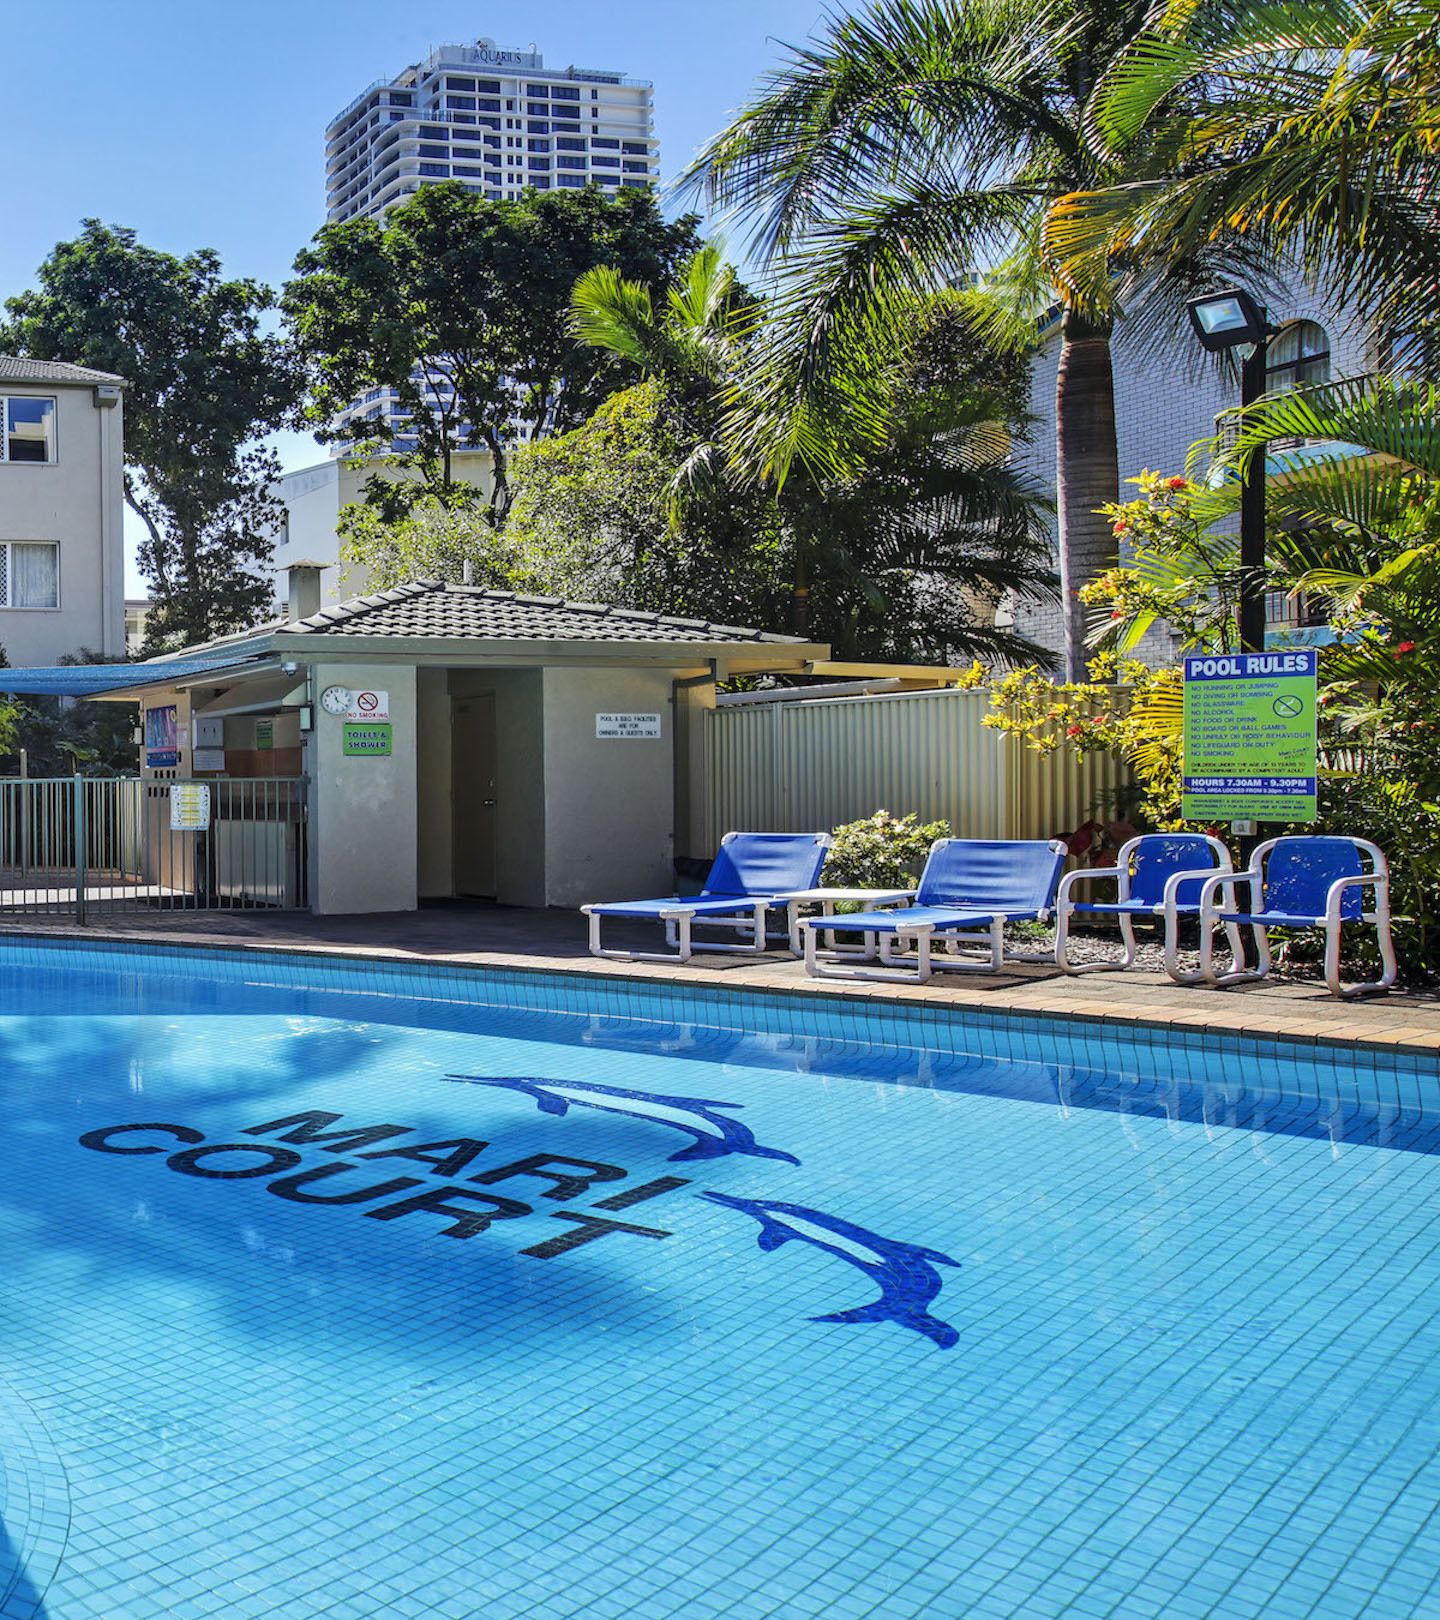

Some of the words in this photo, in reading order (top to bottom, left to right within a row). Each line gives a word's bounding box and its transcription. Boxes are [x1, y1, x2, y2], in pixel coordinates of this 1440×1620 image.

[473, 49, 522, 64] AQUARIUS
[1191, 659, 1242, 677] POOL
[1247, 654, 1309, 674] RULES
[1227, 779, 1262, 787] 7.30AM
[1270, 779, 1307, 787] 9.30PM
[240, 1109, 694, 1212] MARI
[78, 1122, 675, 1259] COURT
